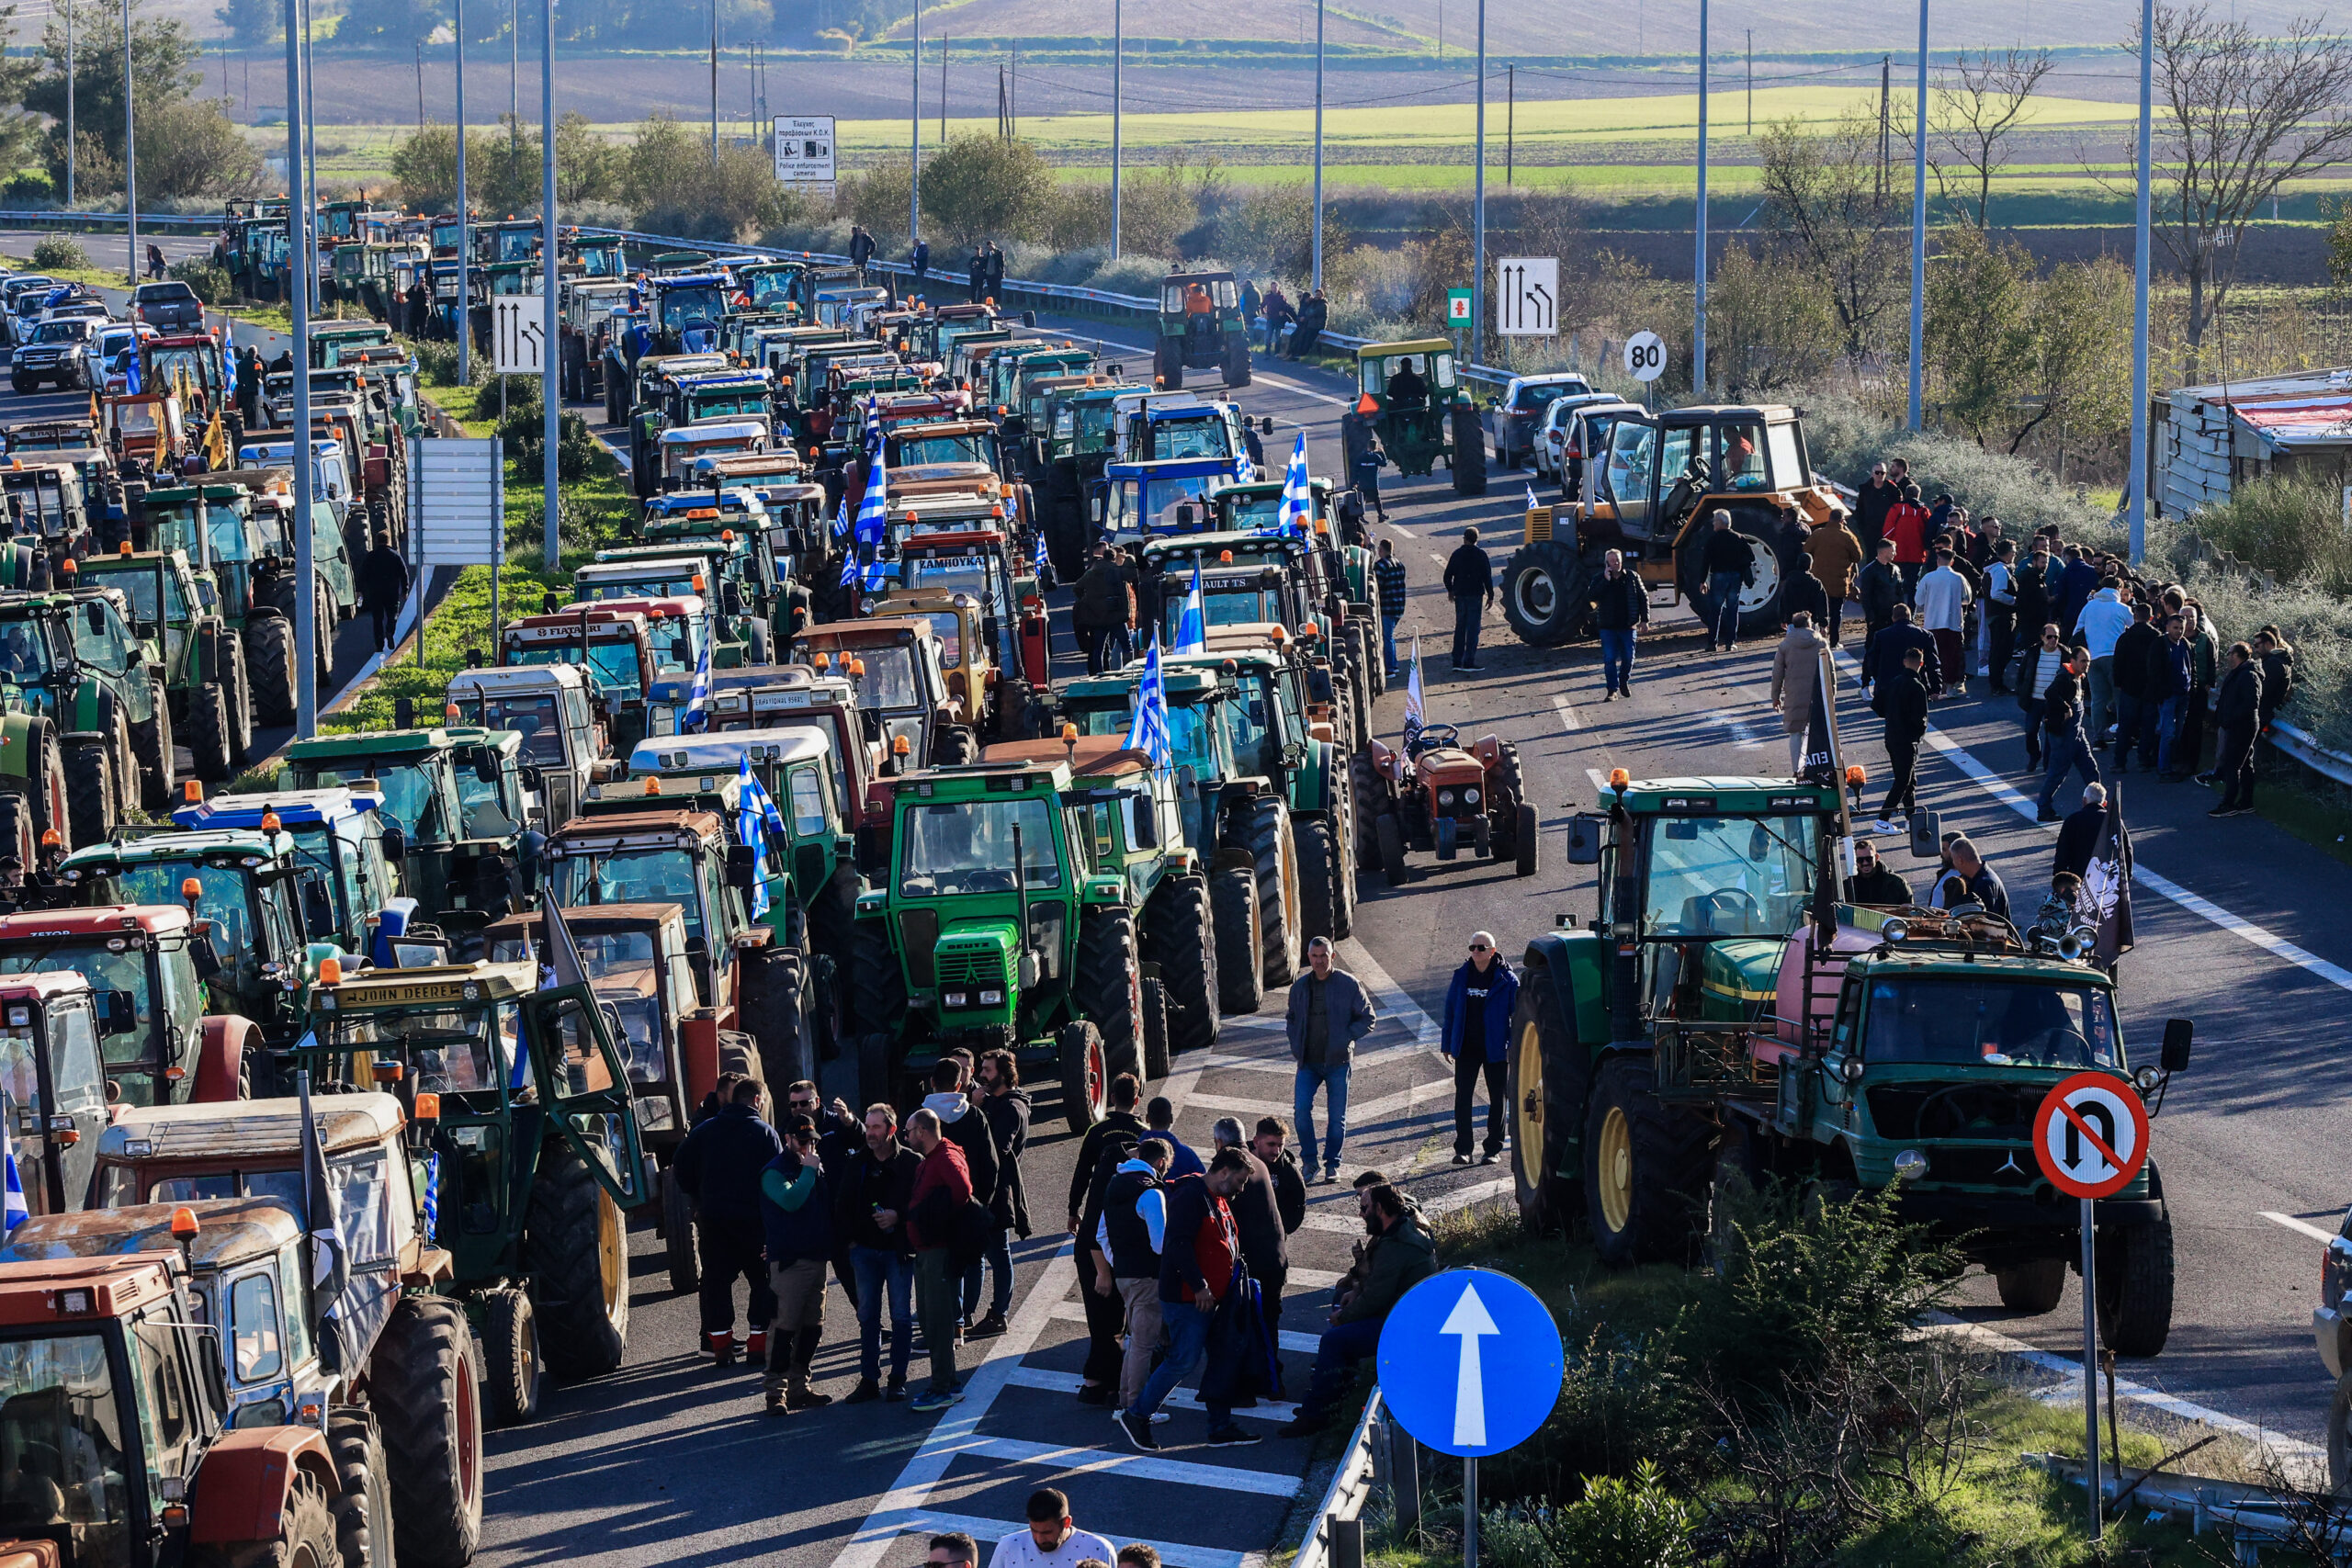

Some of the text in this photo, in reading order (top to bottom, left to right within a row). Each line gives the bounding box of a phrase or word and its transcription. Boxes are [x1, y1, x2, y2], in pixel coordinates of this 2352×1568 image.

[1632, 345, 1658, 368] 80
[1184, 579, 1246, 590] RAULT TS
[549, 626, 601, 635] FIATARI
[358, 986, 449, 1002] JOHN DEERE
